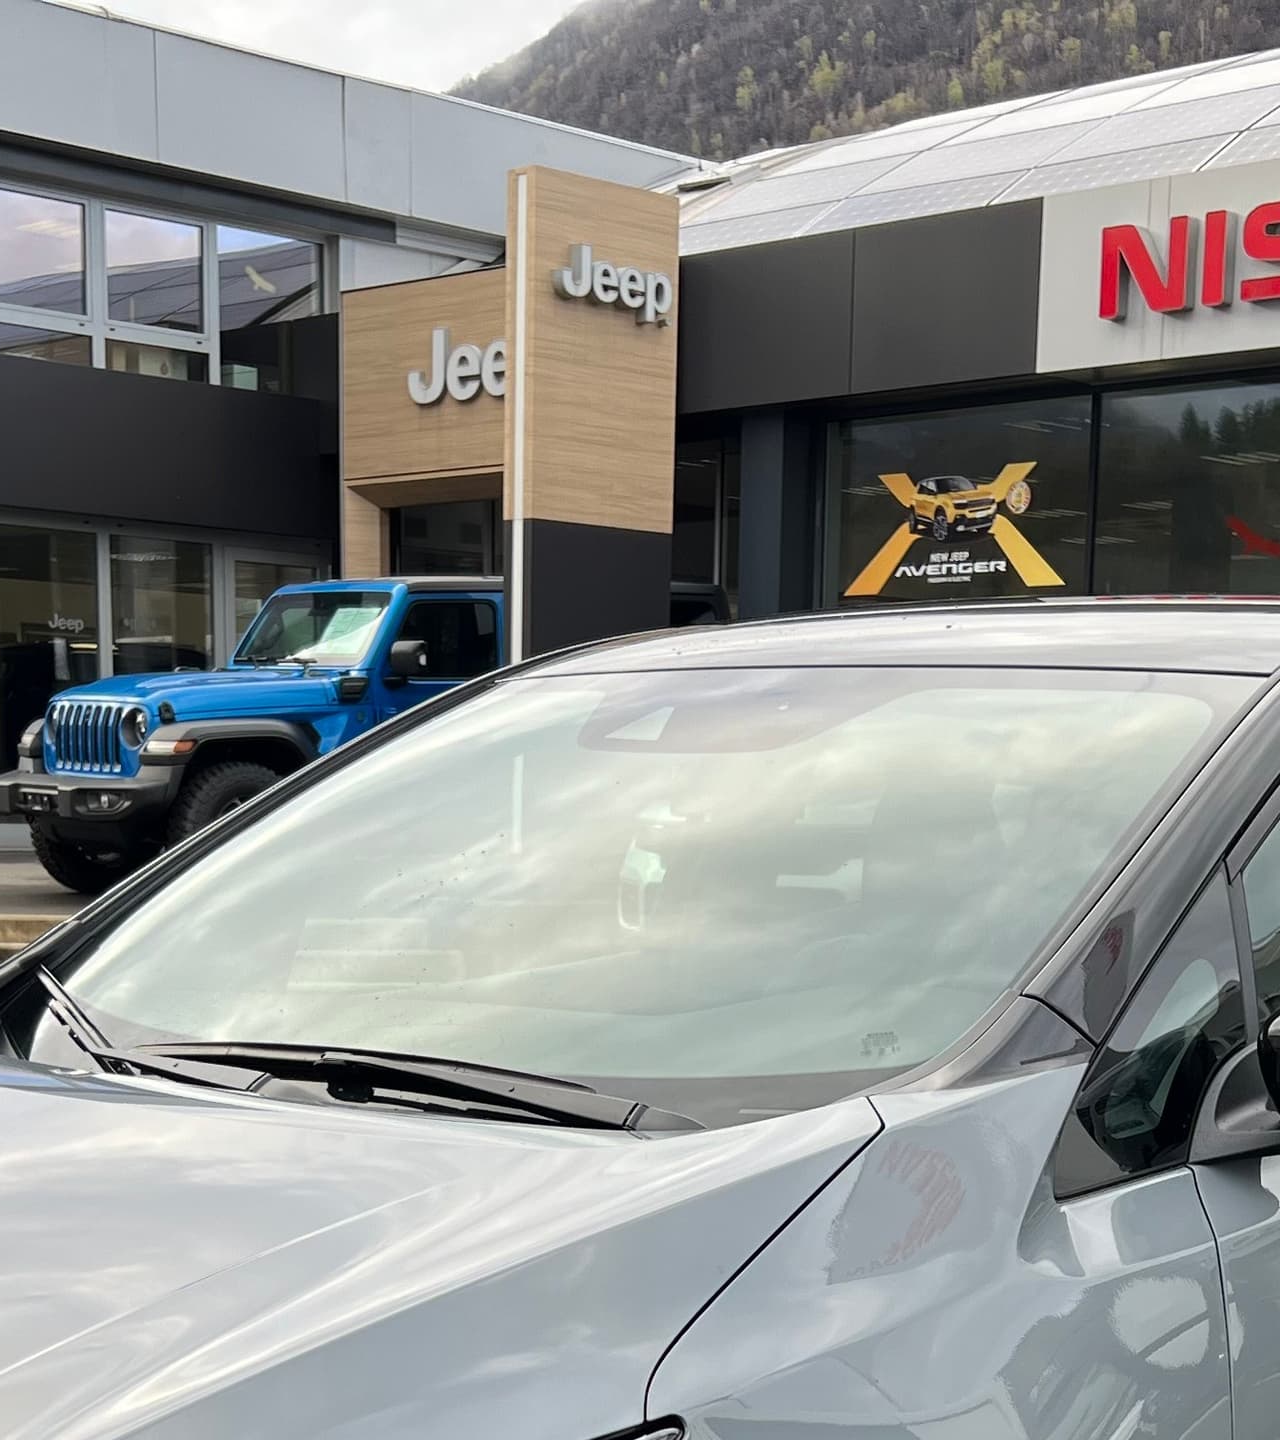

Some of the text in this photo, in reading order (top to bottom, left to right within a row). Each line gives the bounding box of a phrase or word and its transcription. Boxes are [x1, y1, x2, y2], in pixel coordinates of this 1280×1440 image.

[554, 243, 672, 325] Jeep
[407, 326, 506, 405] Jee
[894, 560, 1007, 578] AVENGER
[48, 613, 85, 633] Jeep
